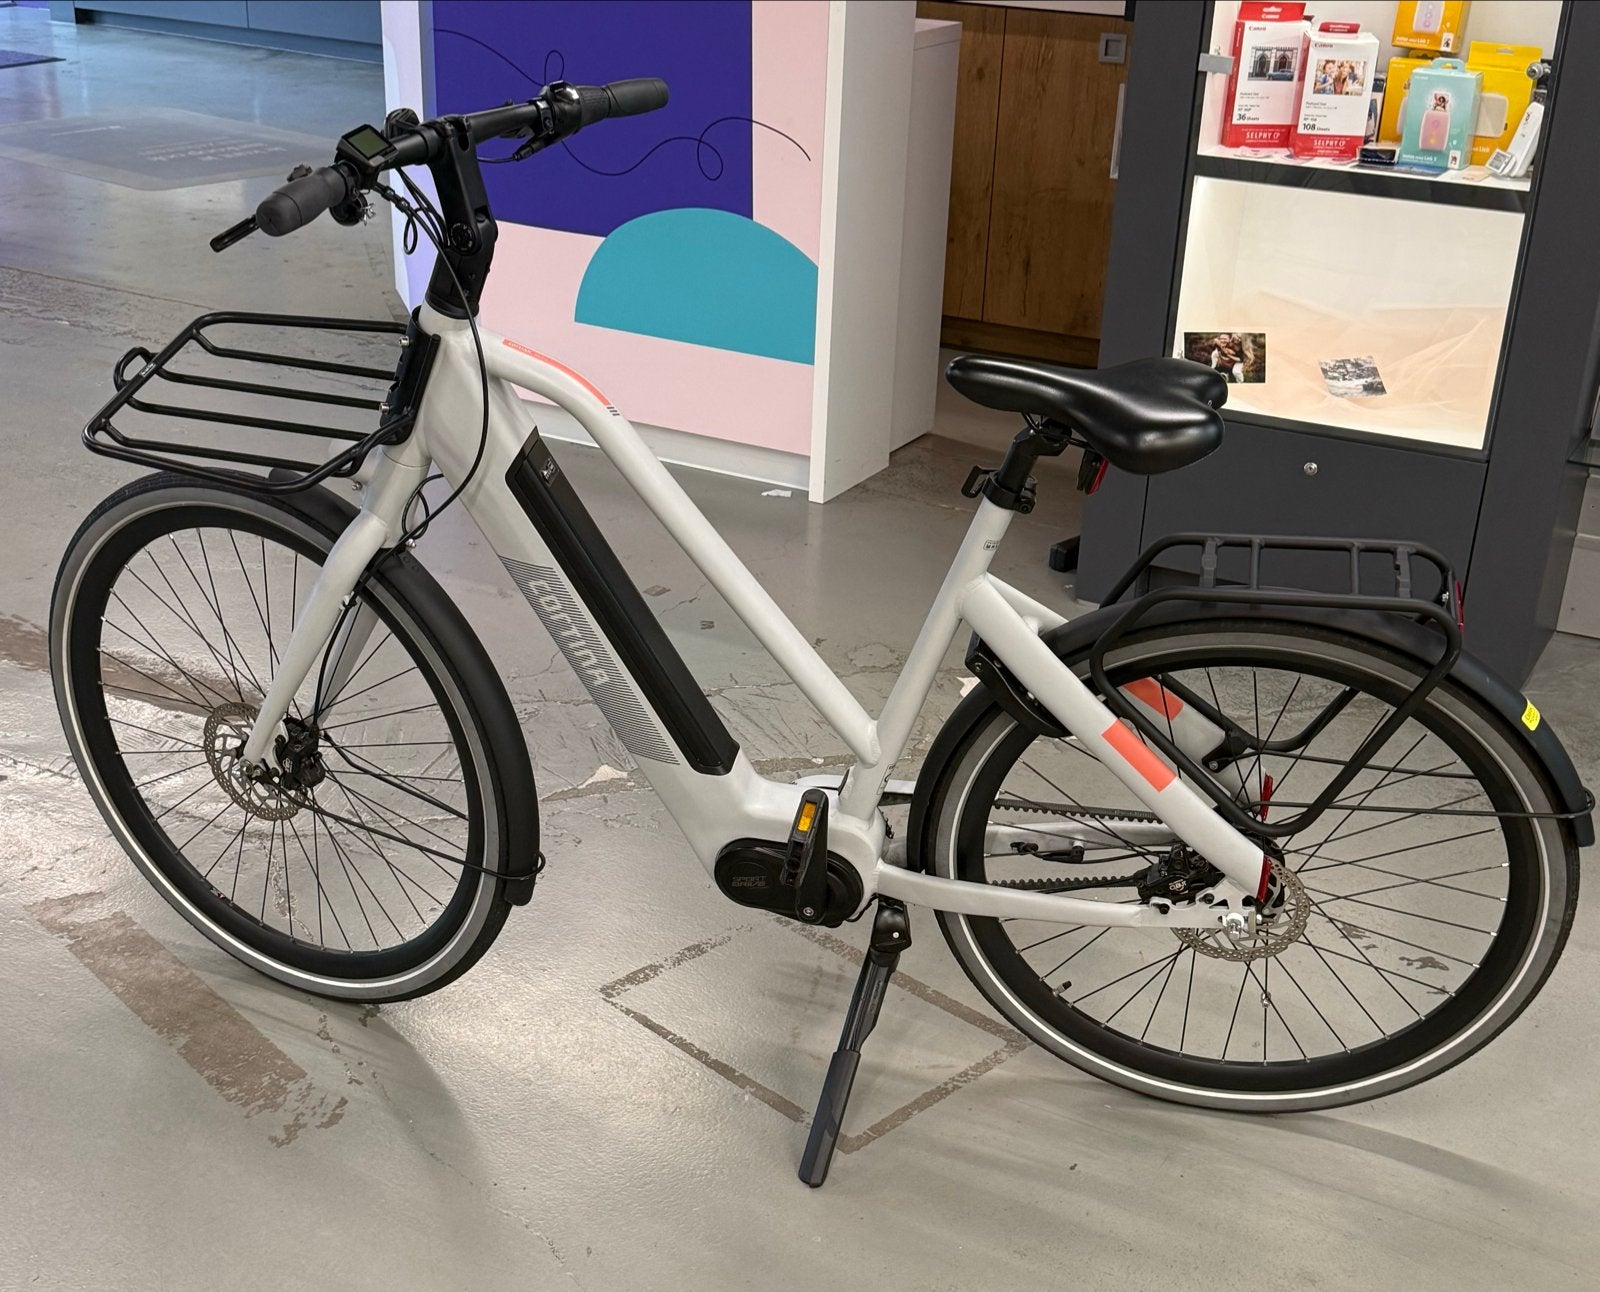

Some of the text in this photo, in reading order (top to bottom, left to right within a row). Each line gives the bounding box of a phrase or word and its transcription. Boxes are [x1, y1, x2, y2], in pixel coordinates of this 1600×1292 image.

[1236, 113, 1247, 121] 36
[1302, 123, 1316, 131] 108
[1246, 131, 1273, 139] SELPHY
